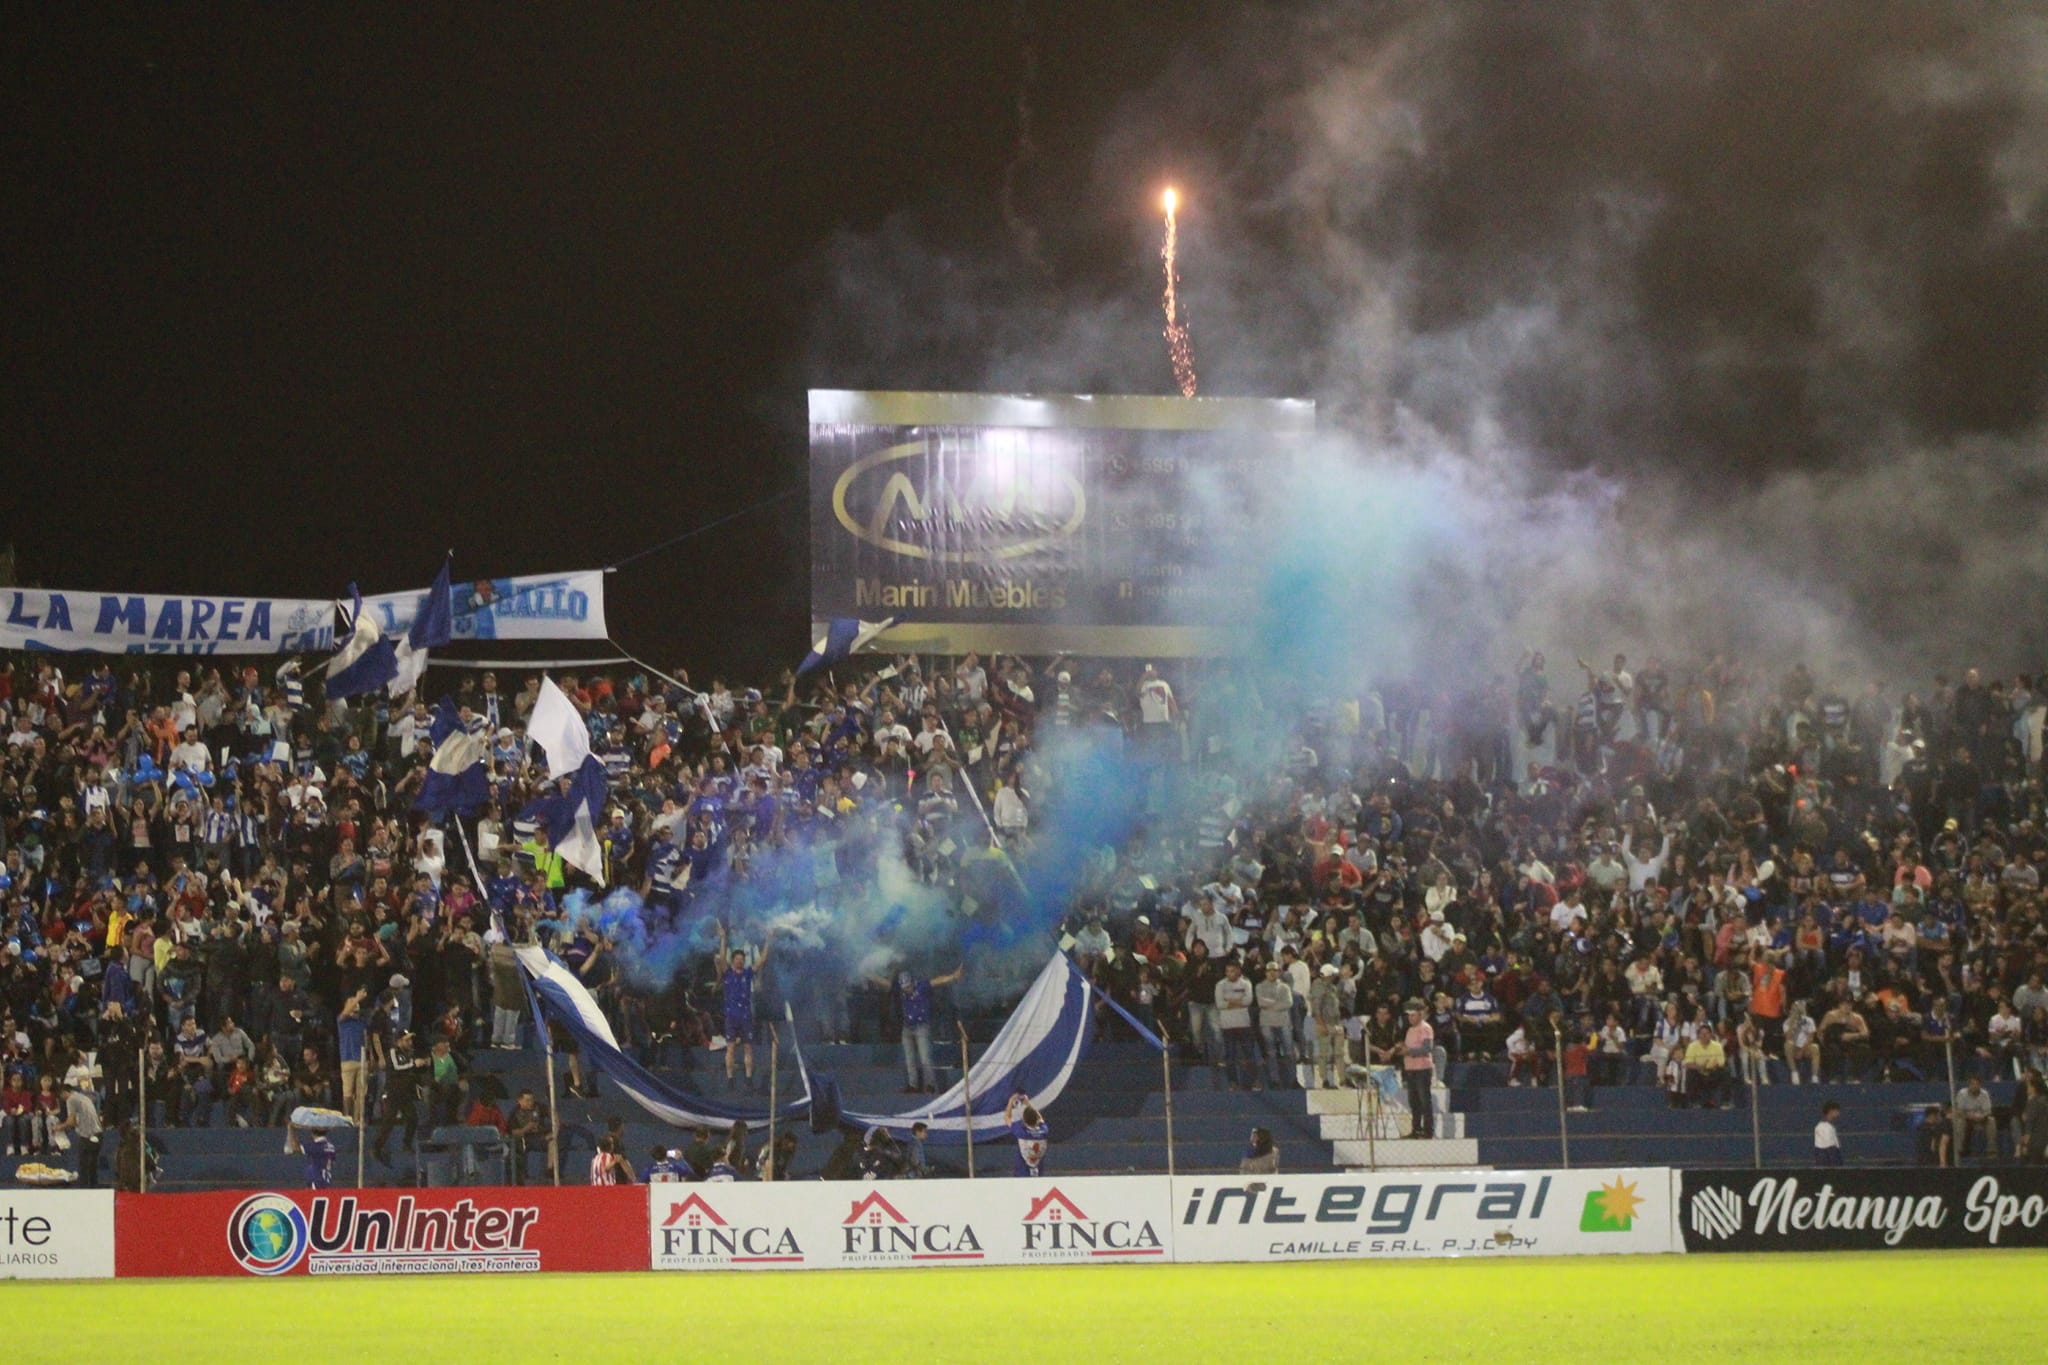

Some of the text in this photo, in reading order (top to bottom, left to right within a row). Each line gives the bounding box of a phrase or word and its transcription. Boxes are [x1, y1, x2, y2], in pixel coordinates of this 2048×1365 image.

[856, 578, 1067, 609] Marin Muebles
[6, 592, 73, 632] LA
[95, 597, 272, 640] MAREA
[1183, 1176, 1552, 1234] integral
[1749, 1177, 1947, 1245] Netanya
[0, 1206, 52, 1246] te
[309, 1196, 539, 1252] UnInter
[842, 1224, 983, 1253] FINCA
[1021, 1220, 1163, 1249] FINCA
[661, 1227, 804, 1255] FINCA
[1269, 1241, 1361, 1254] CAMILLE
[310, 1259, 538, 1273] Universidad Internacional Tres Fronteras
[660, 1256, 731, 1264] PROPIEDADES
[842, 1254, 913, 1262] PROPIEDADES
